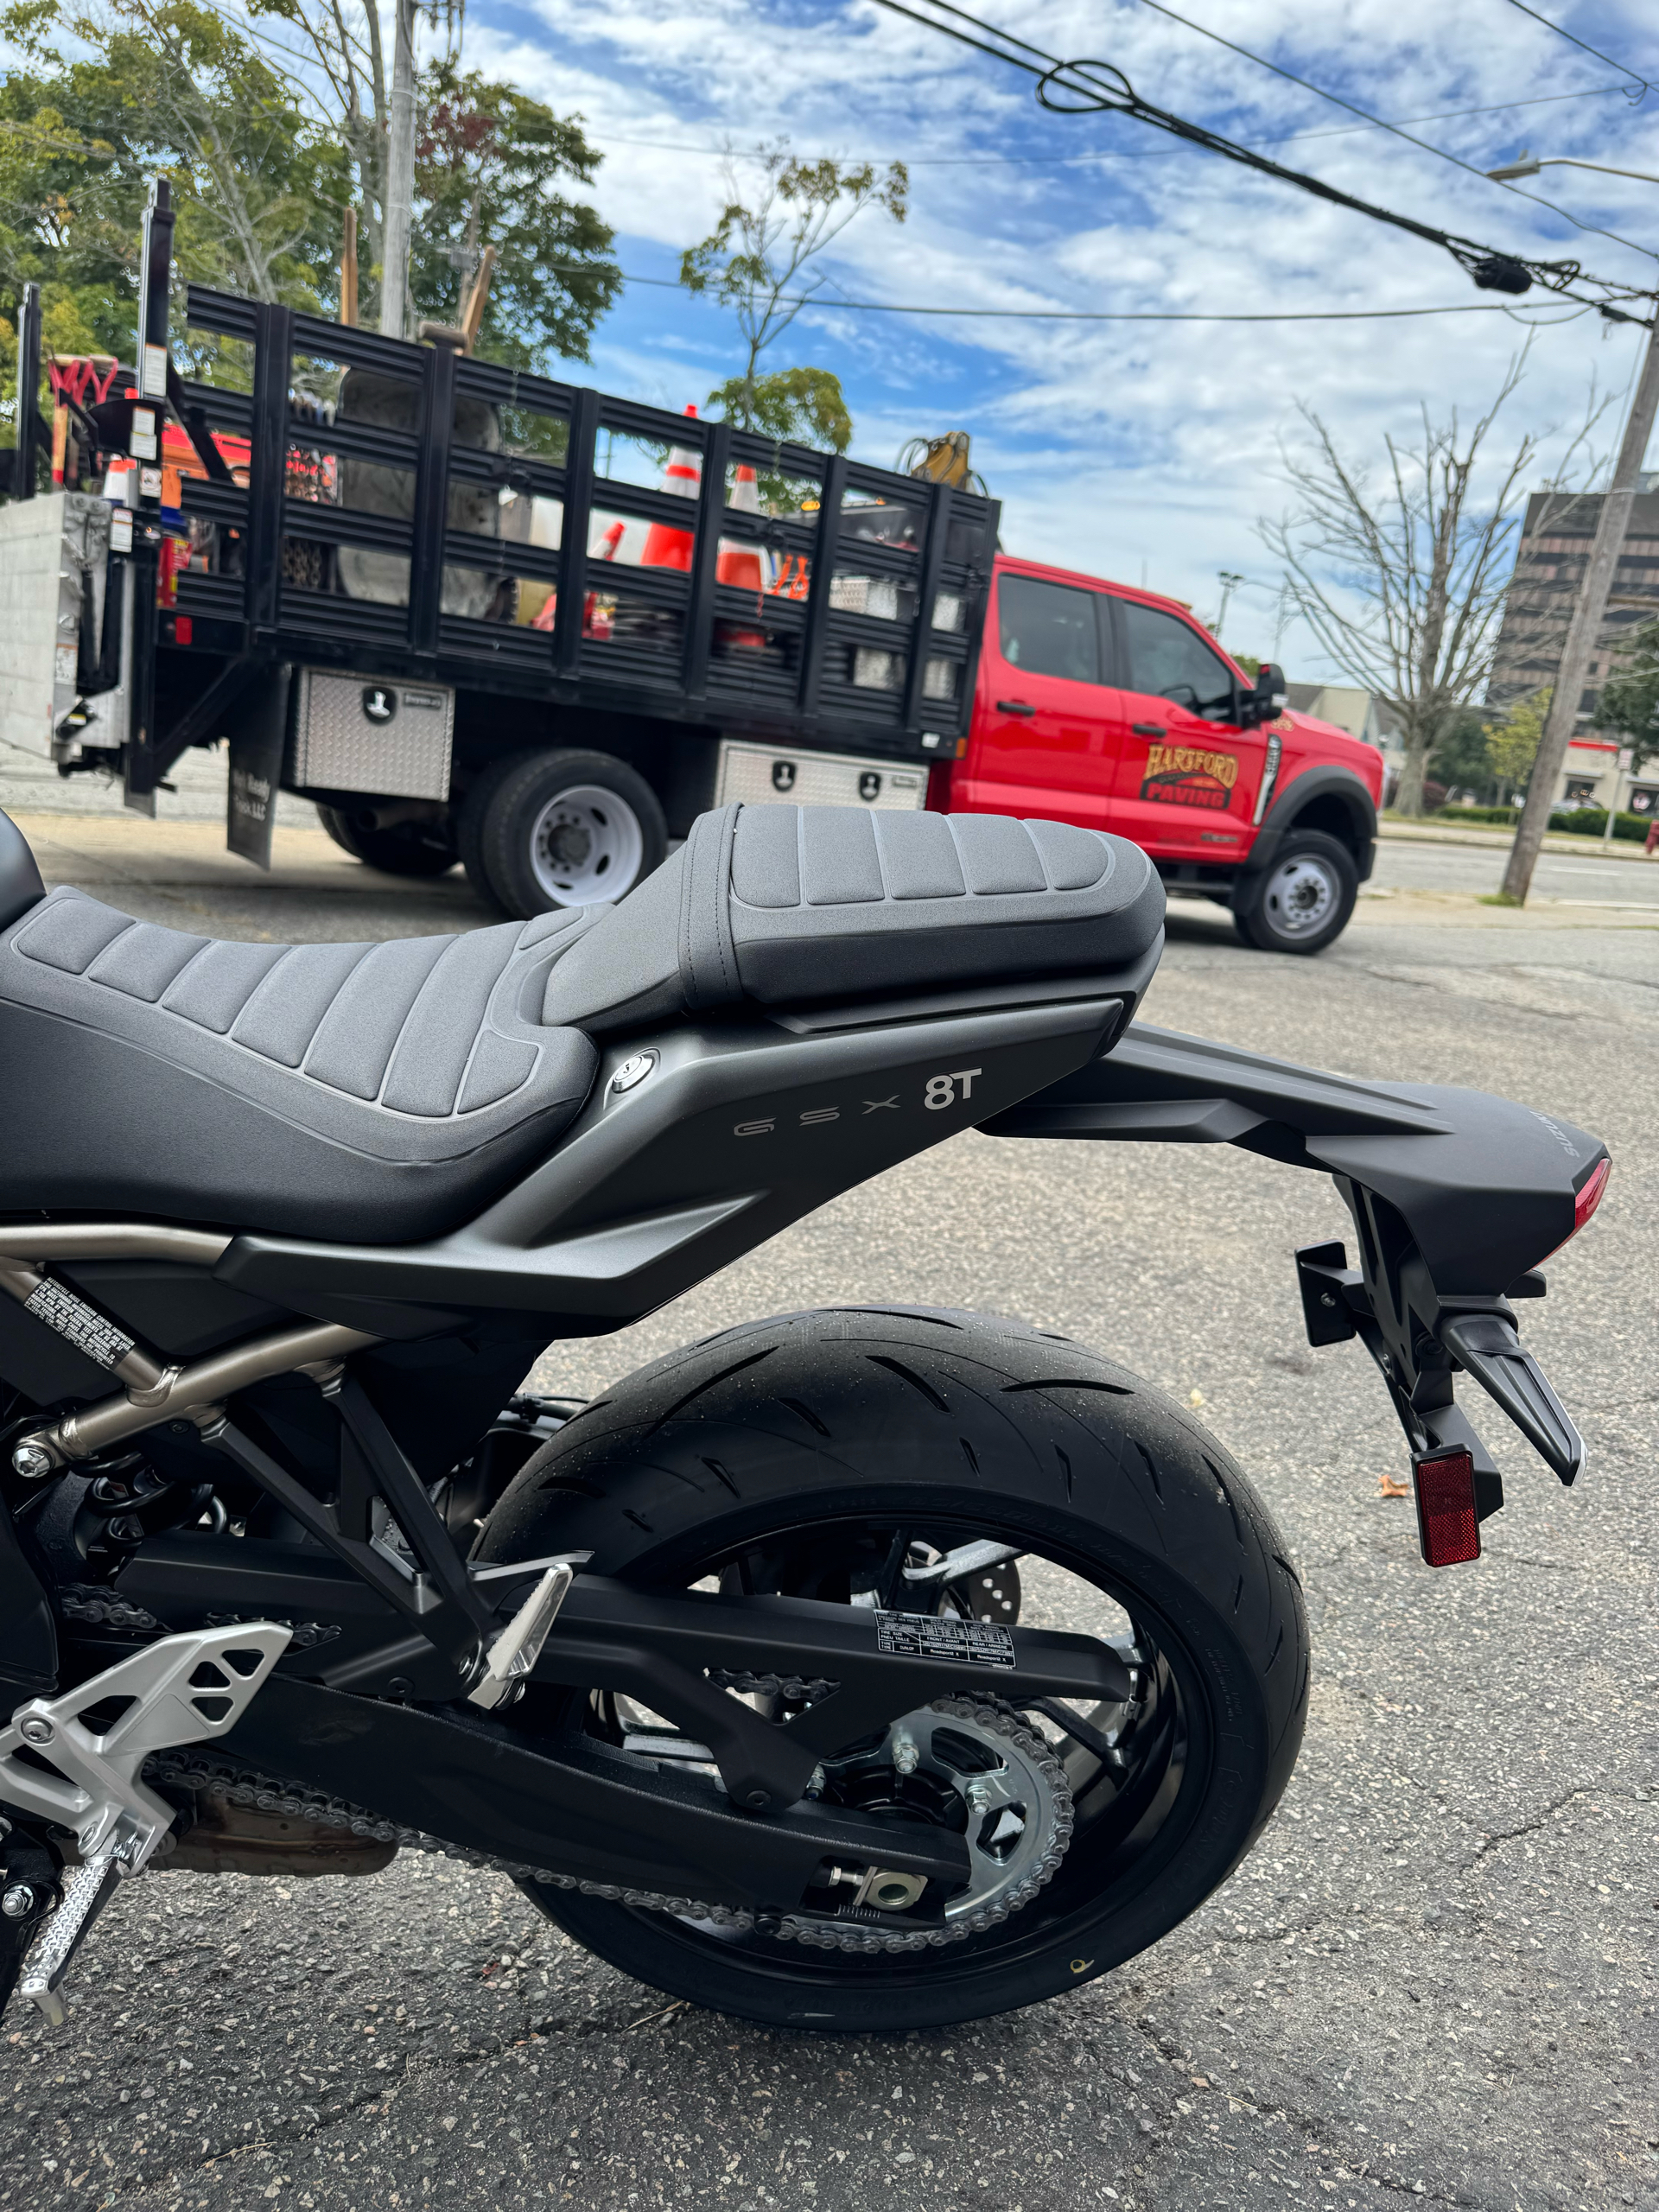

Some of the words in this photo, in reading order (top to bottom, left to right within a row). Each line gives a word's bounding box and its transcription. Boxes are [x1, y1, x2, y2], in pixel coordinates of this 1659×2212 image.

[1143, 743, 1238, 789] HARTFORD
[1147, 782, 1225, 807] PAVING
[924, 1067, 983, 1110] 8T
[1529, 1110, 1580, 1158] SUZUKI
